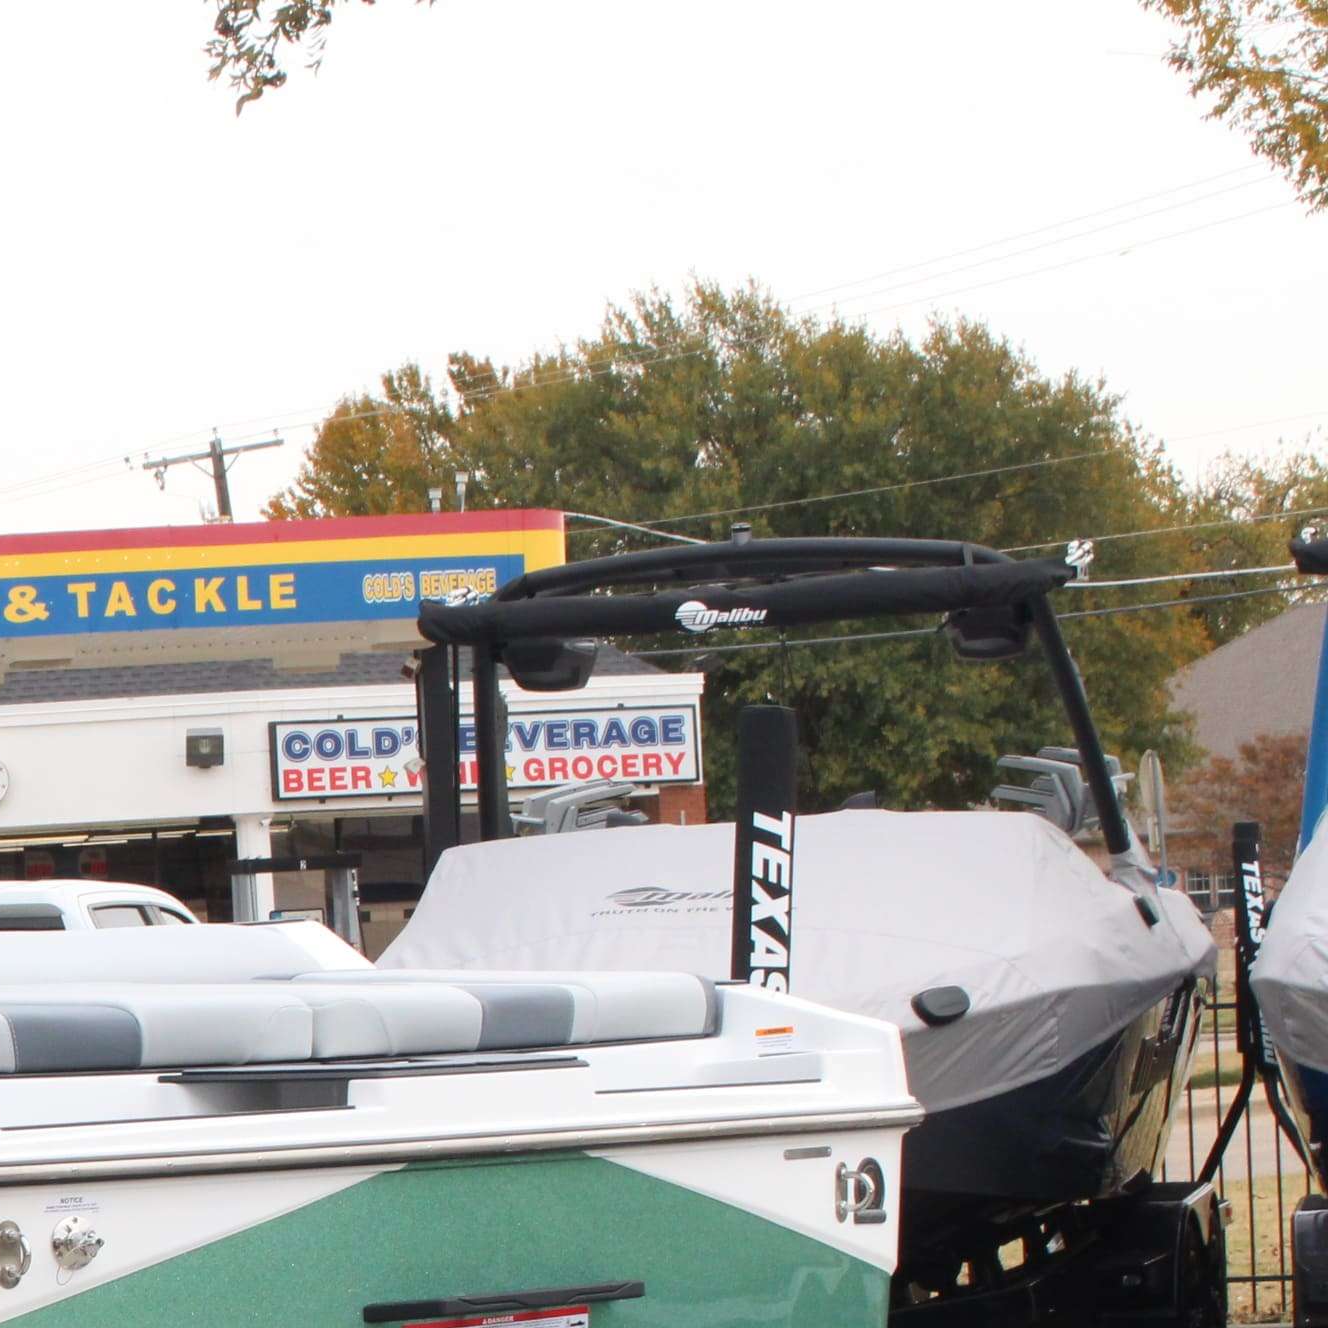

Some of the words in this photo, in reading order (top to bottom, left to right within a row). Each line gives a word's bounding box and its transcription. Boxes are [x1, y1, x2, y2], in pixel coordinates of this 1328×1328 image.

[3, 584, 50, 624] &
[67, 573, 298, 618] TACKLE
[362, 572, 416, 603] COLD'S
[281, 726, 421, 763] COLD'
[282, 765, 373, 793] BEER
[523, 751, 688, 782] GROCERY
[748, 810, 793, 995] TEXAS
